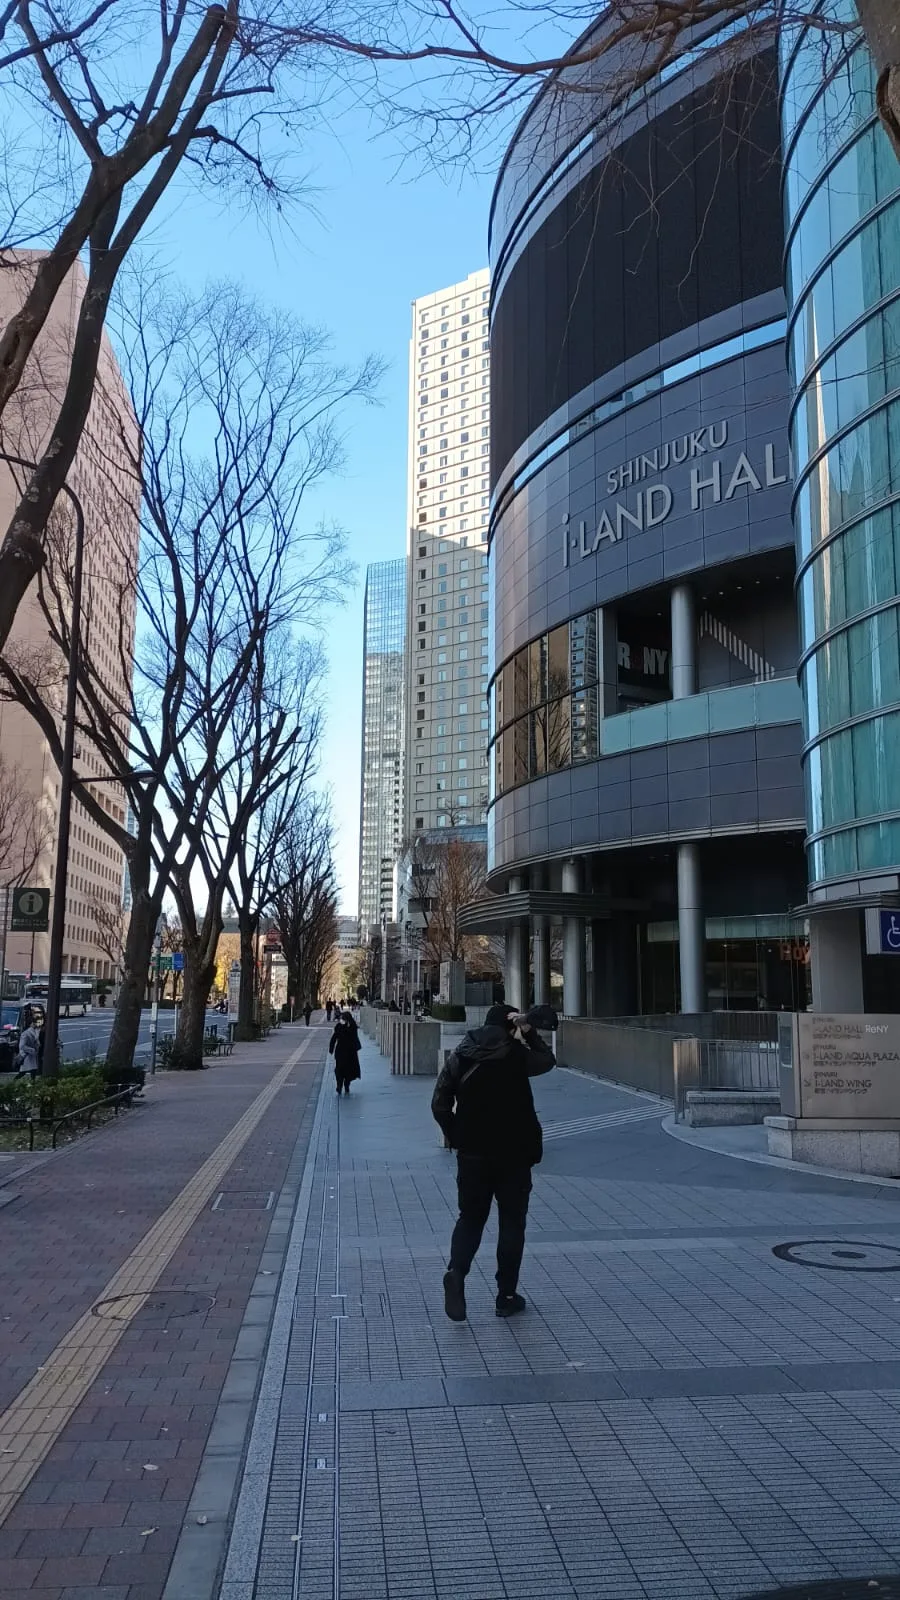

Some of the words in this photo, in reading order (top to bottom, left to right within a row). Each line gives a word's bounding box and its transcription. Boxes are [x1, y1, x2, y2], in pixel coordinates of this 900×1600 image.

[607, 421, 728, 494] SHINJUKU
[812, 1025, 842, 1033] -LAND
[865, 1024, 889, 1033] ReNY
[845, 1052, 871, 1060] AQUA
[873, 1052, 900, 1060] PLAZA
[846, 1080, 872, 1088] WING
